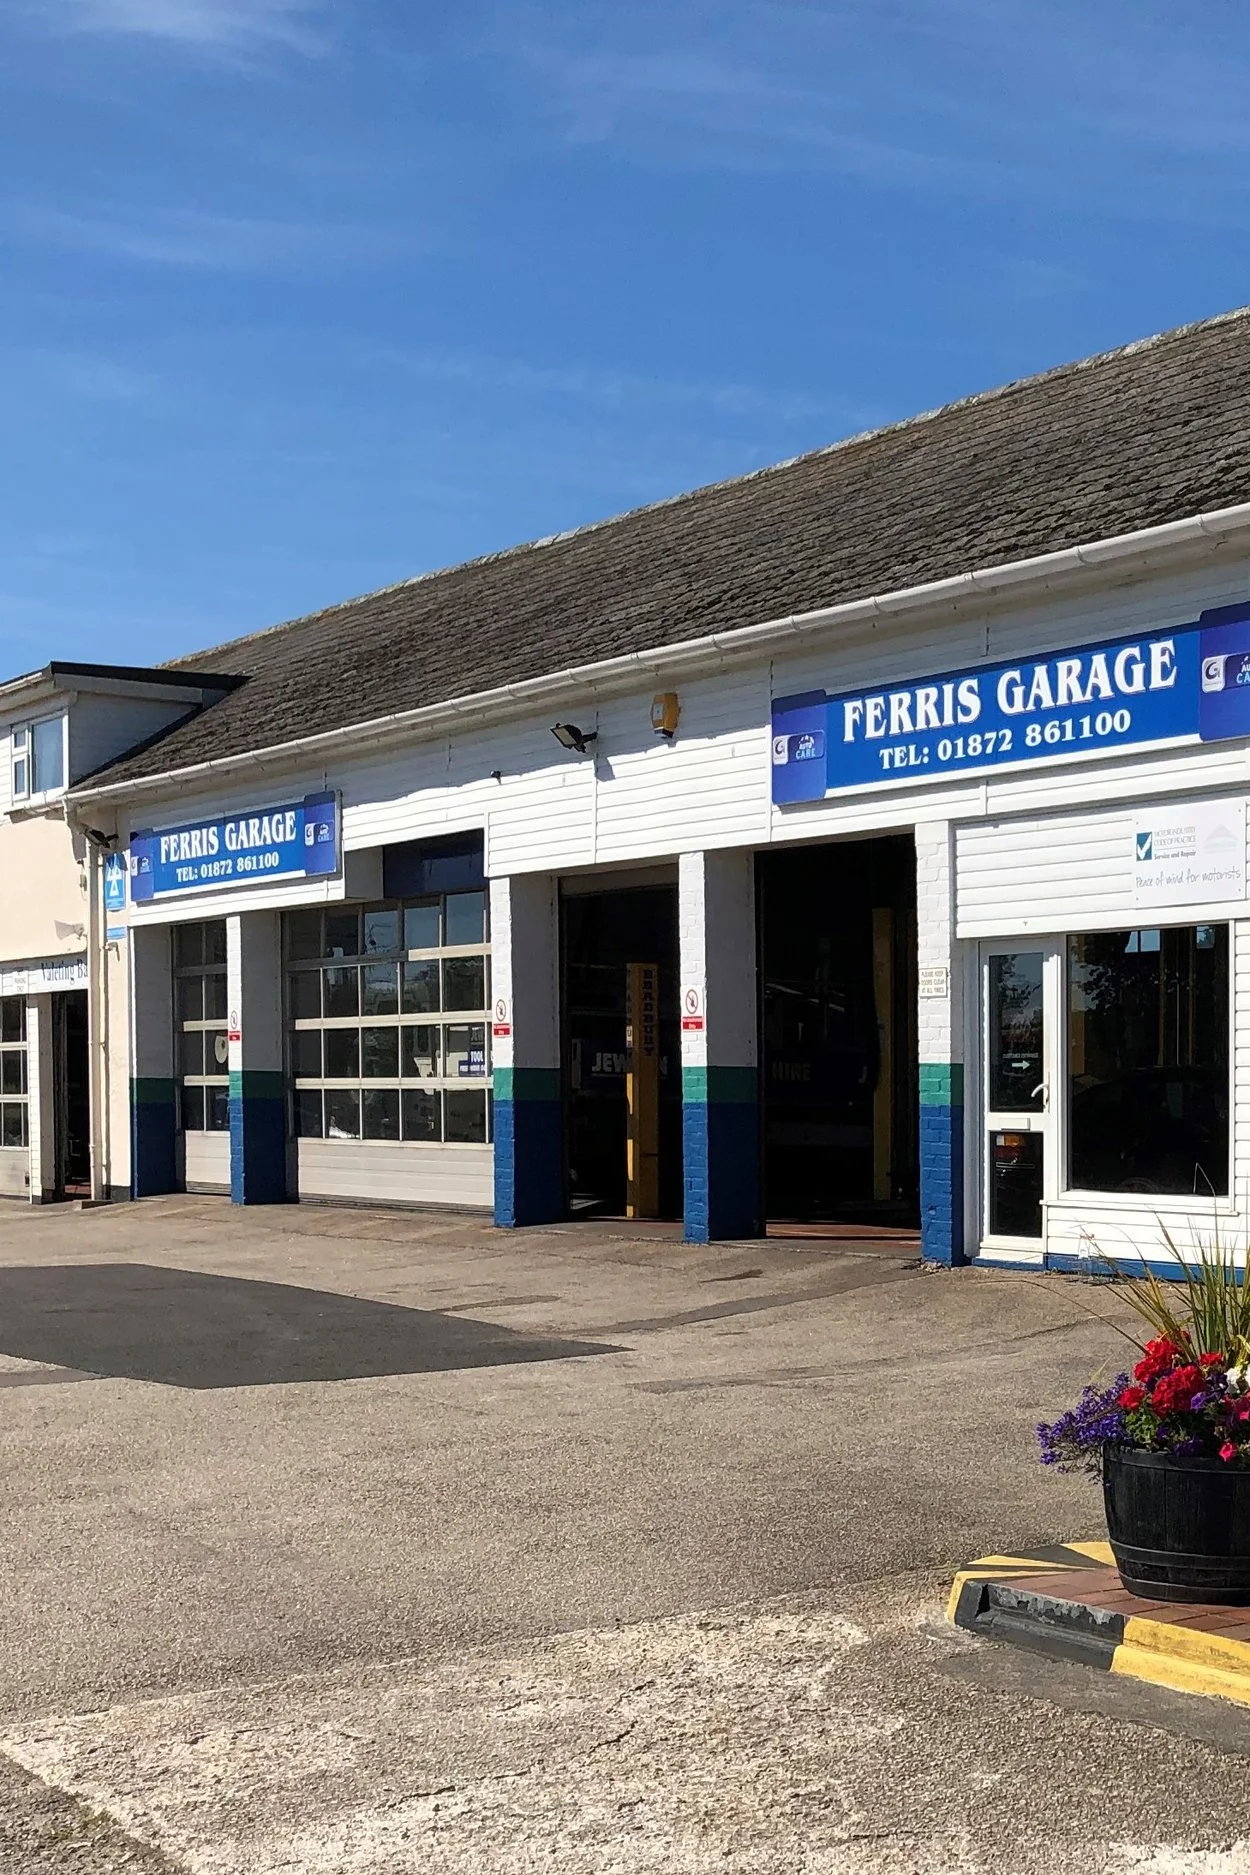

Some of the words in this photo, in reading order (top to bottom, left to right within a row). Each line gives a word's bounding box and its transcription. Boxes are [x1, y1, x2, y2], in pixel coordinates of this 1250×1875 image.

[843, 679, 981, 743] FERRIS
[997, 640, 1177, 717] GARAGE
[795, 748, 816, 760] CARE
[880, 744, 930, 770] TEL:
[937, 731, 1012, 761] 01872
[1025, 709, 1131, 748] 861100
[160, 826, 219, 864] FERRIS
[225, 811, 296, 851] GARAGE
[176, 866, 198, 882] TEL:
[200, 859, 232, 877] 01872
[237, 851, 279, 872] 861100
[1136, 876, 1153, 888] Peace
[1156, 870, 1163, 886] of
[1166, 871, 1184, 884] mind
[1186, 868, 1200, 884] for
[1202, 865, 1240, 882] motorists
[41, 961, 75, 985] Valeting
